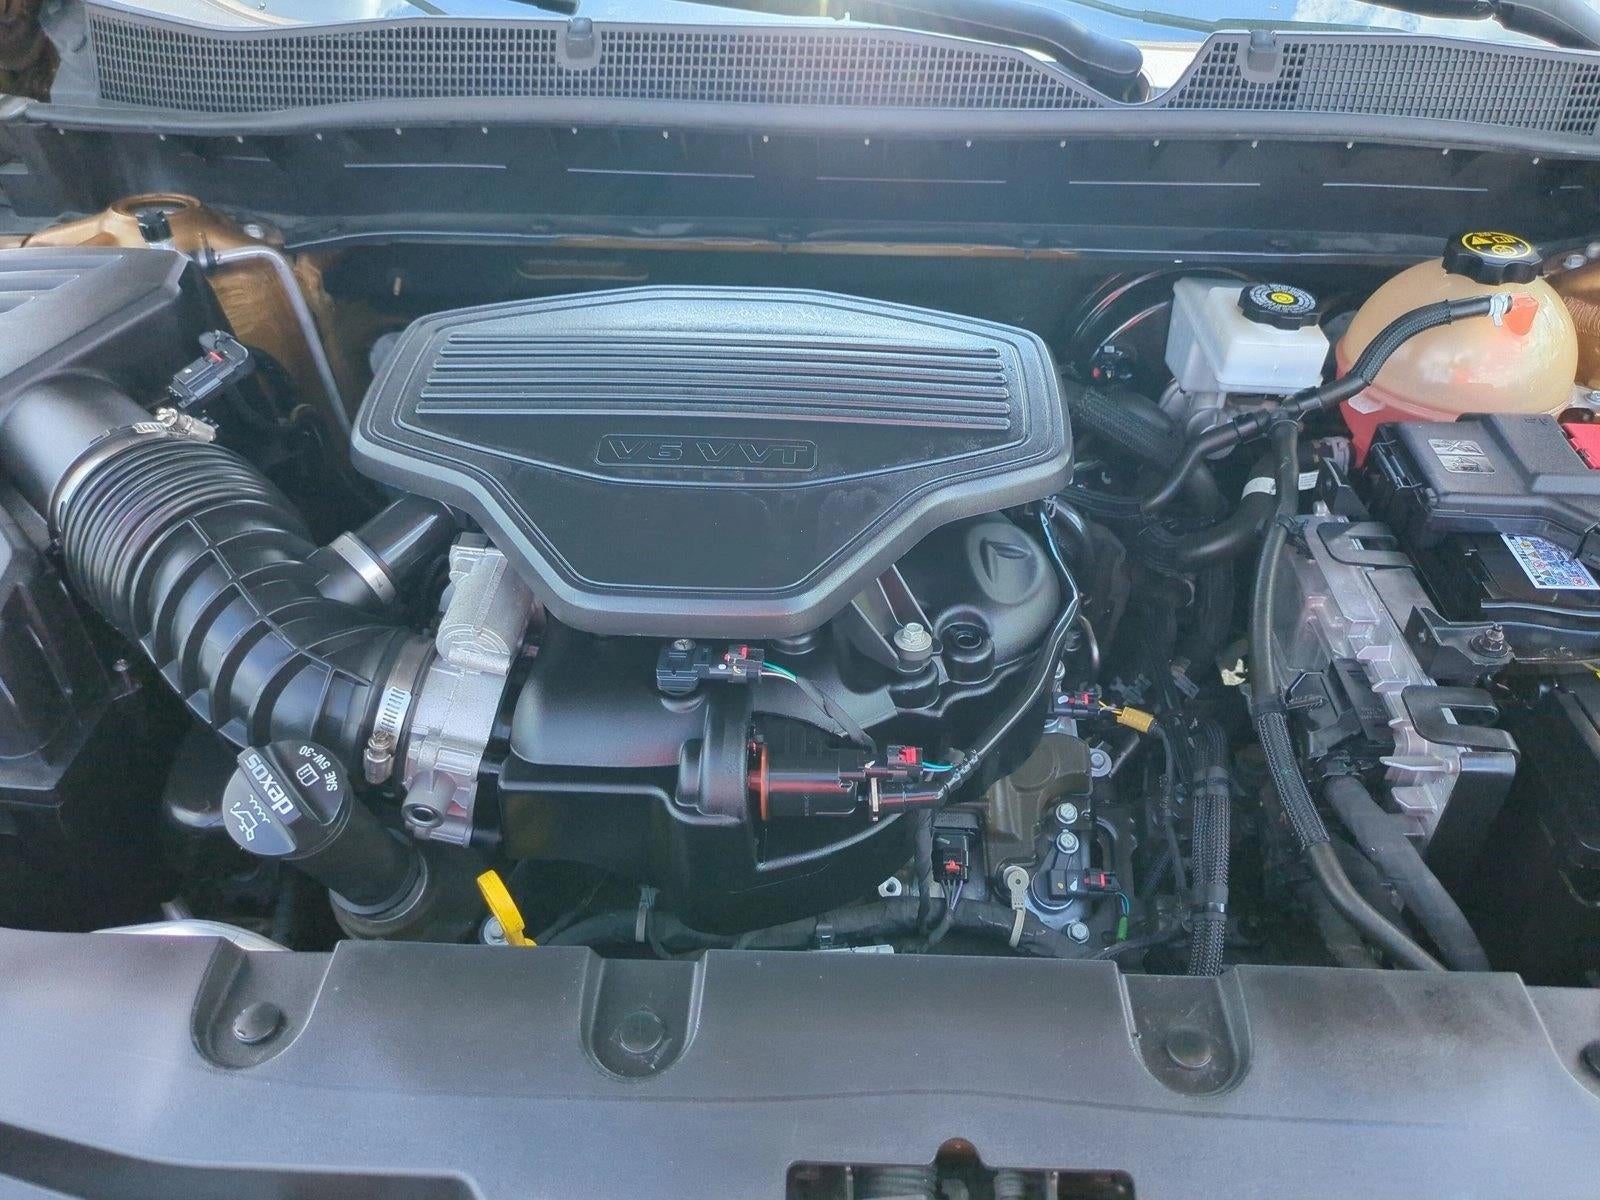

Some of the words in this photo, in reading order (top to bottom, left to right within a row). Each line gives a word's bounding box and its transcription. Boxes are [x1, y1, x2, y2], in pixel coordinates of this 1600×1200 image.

[608, 439, 683, 461] V6
[695, 440, 808, 465] VVT
[299, 745, 331, 770] 5W-30
[243, 753, 294, 815] dexos
[324, 770, 338, 792] SAE
